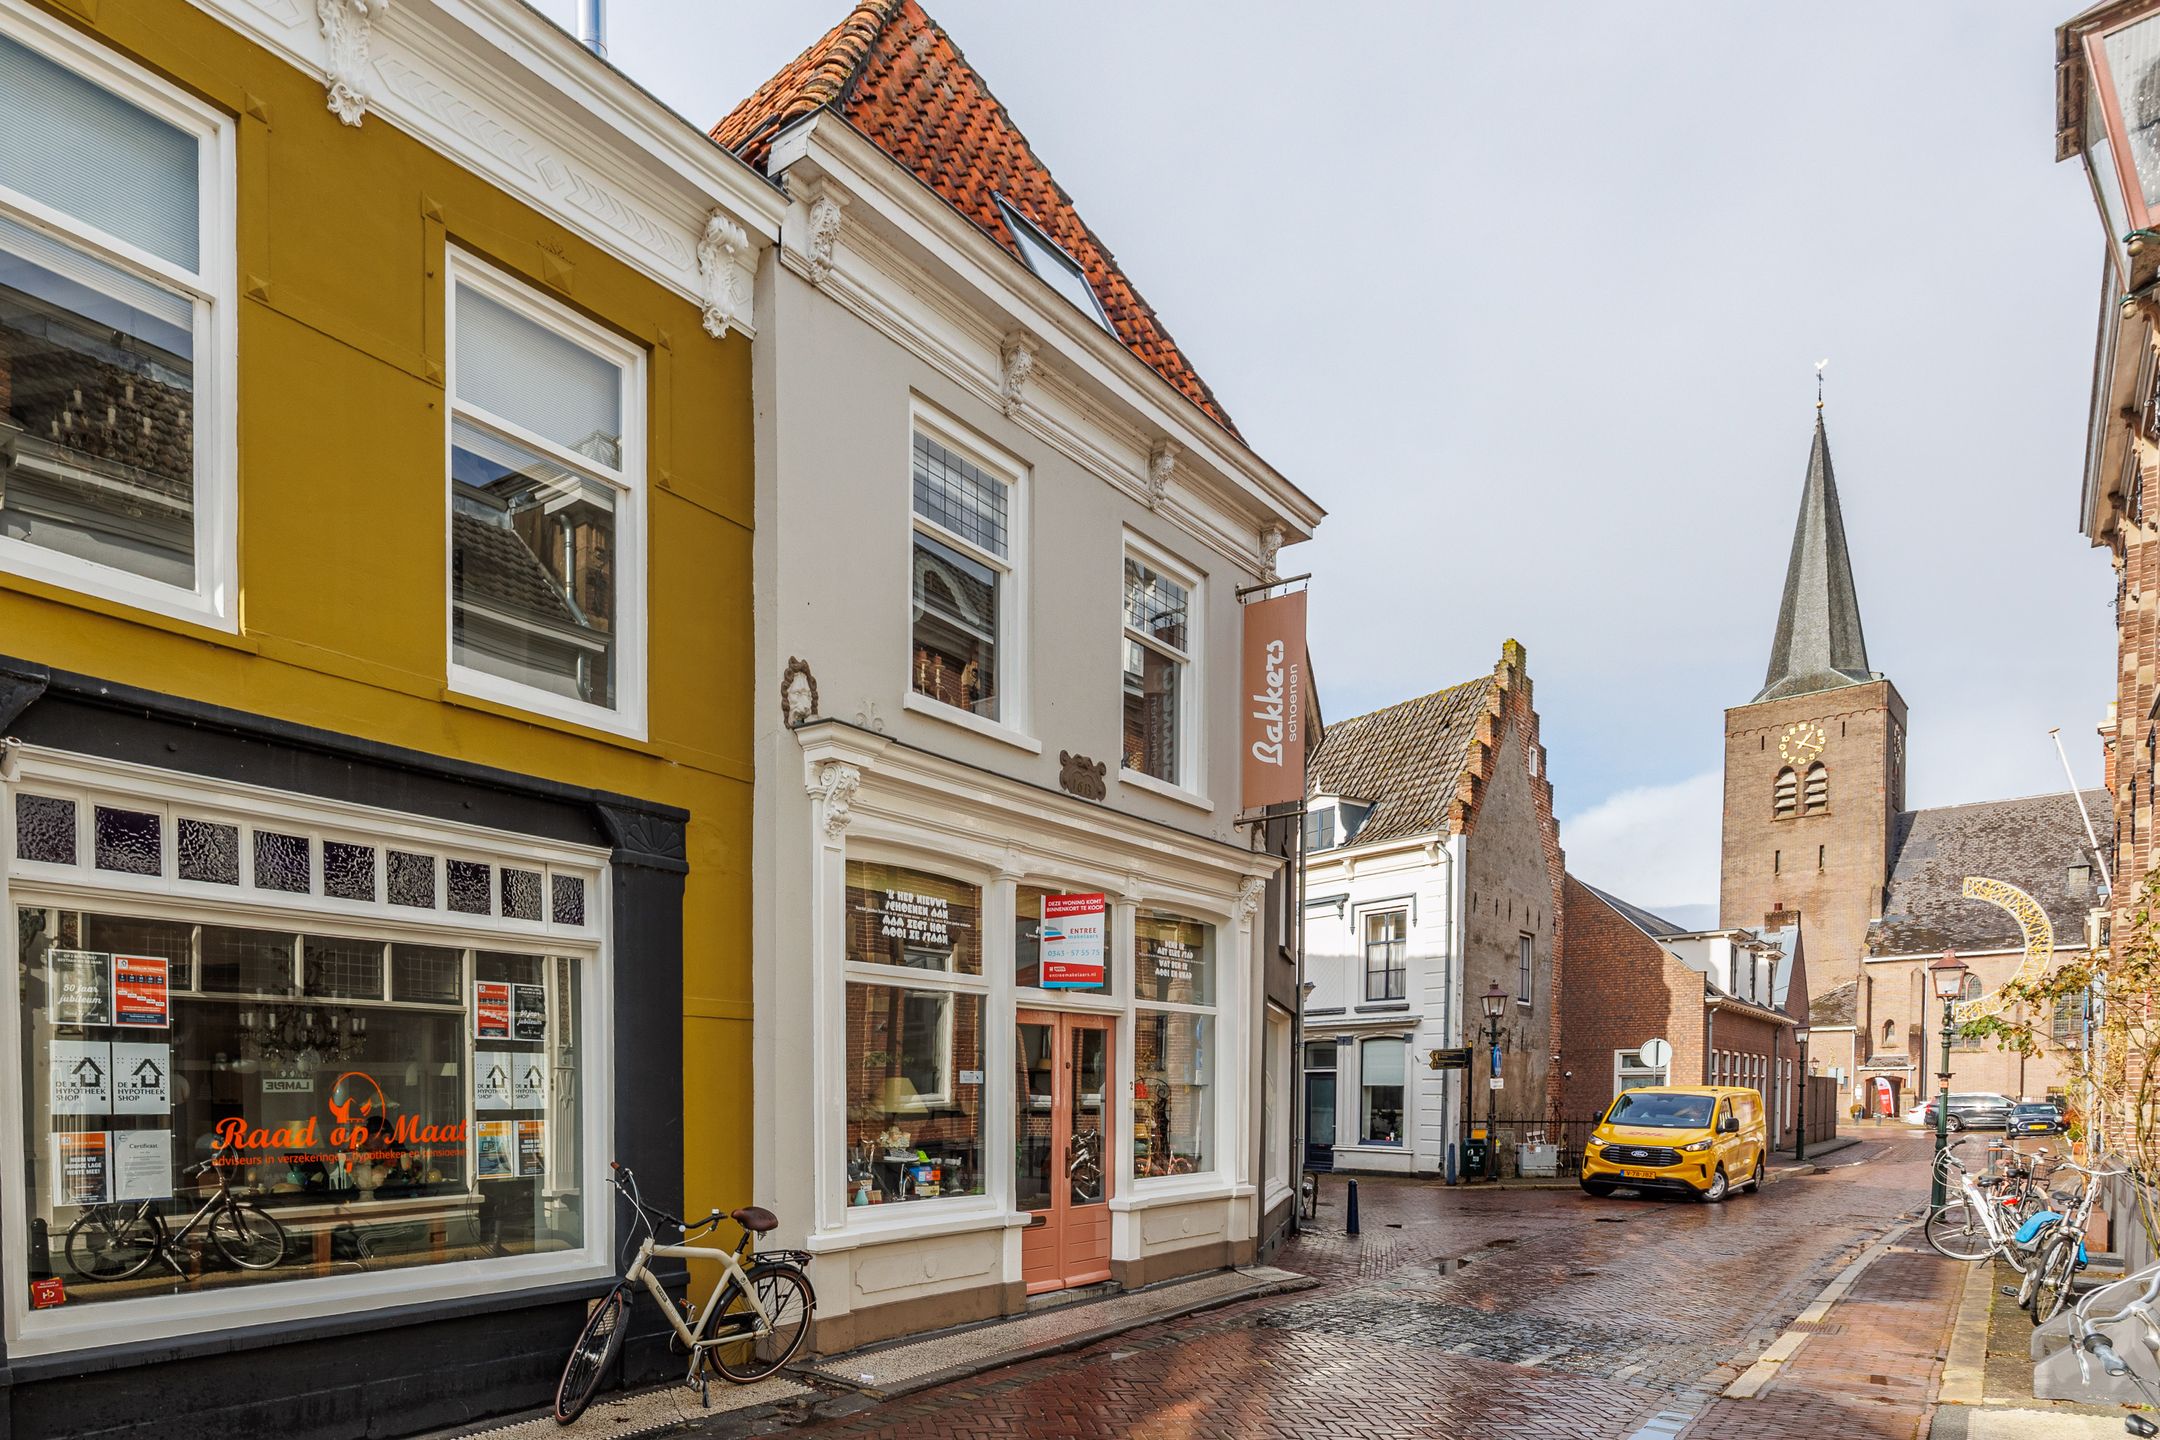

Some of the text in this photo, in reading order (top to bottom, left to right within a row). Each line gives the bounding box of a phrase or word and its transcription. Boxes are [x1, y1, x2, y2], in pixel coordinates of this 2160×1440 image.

[1252, 640, 1284, 767] Bakkers
[1289, 663, 1298, 742] schoenen
[916, 894, 947, 908] NIEUWE
[885, 900, 928, 917] SCHOENEN
[931, 908, 948, 920] AAN
[907, 919, 927, 931] ZEGT
[930, 922, 946, 934] HOE
[882, 926, 948, 945] MOOI ZE STAAN
[1159, 959, 1170, 968] WAT
[75, 984, 98, 994] jaar
[58, 994, 103, 1004] jubileum
[211, 1113, 468, 1163] Raad op Maat
[212, 1155, 262, 1166] adviseurs
[265, 1155, 274, 1164] in
[352, 1149, 406, 1162] hypotheken
